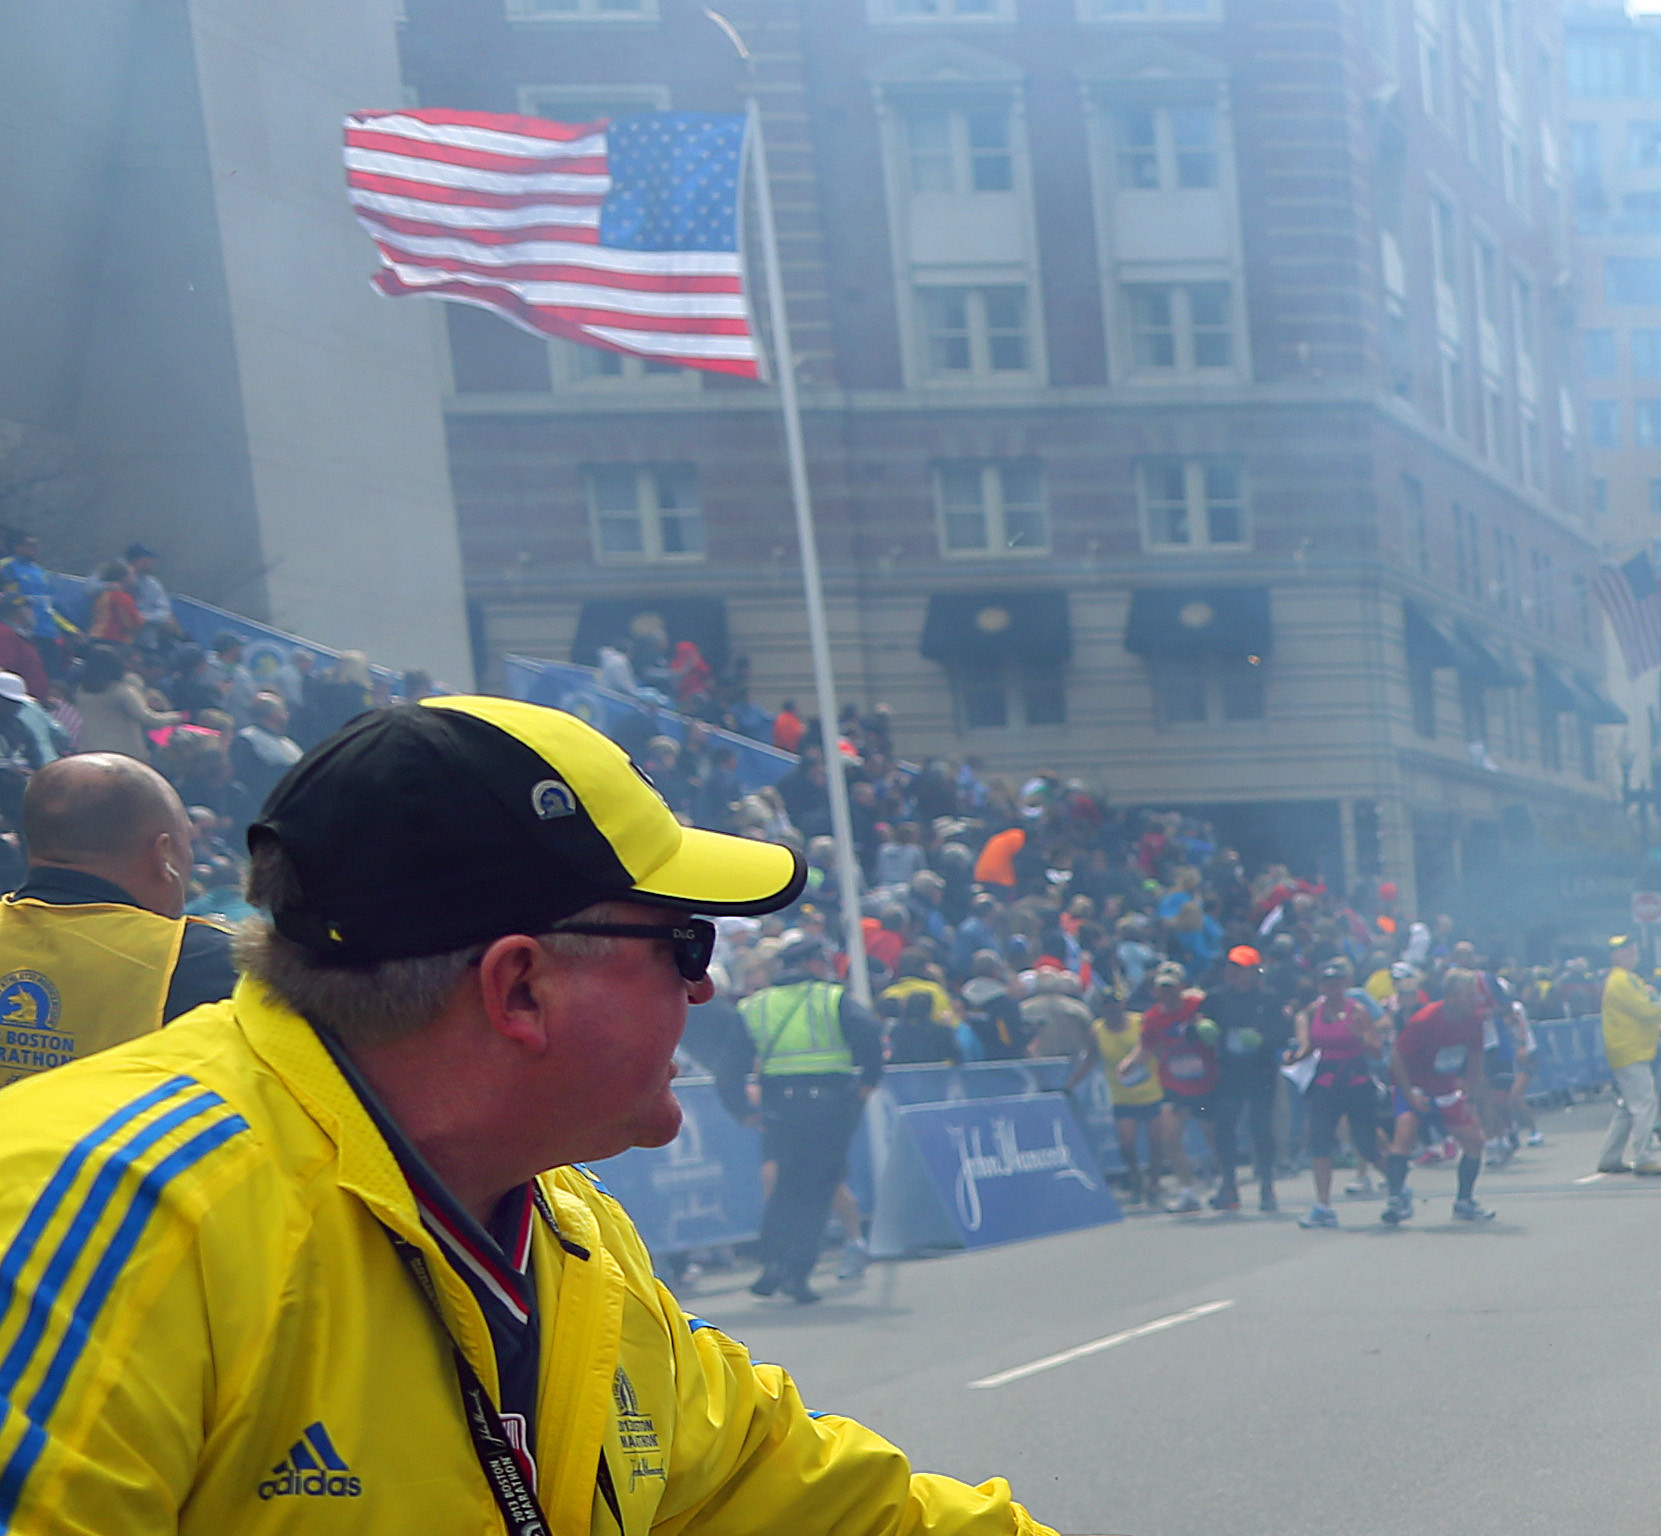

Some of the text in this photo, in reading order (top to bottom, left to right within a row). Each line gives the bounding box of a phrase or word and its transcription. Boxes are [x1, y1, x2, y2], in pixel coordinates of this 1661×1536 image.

[6, 1031, 75, 1052] BOSTON
[258, 1468, 363, 1501] adidas
[489, 1459, 515, 1499] BOSTON
[502, 1456, 538, 1520] MARATHON
[509, 1499, 526, 1524] 2013
